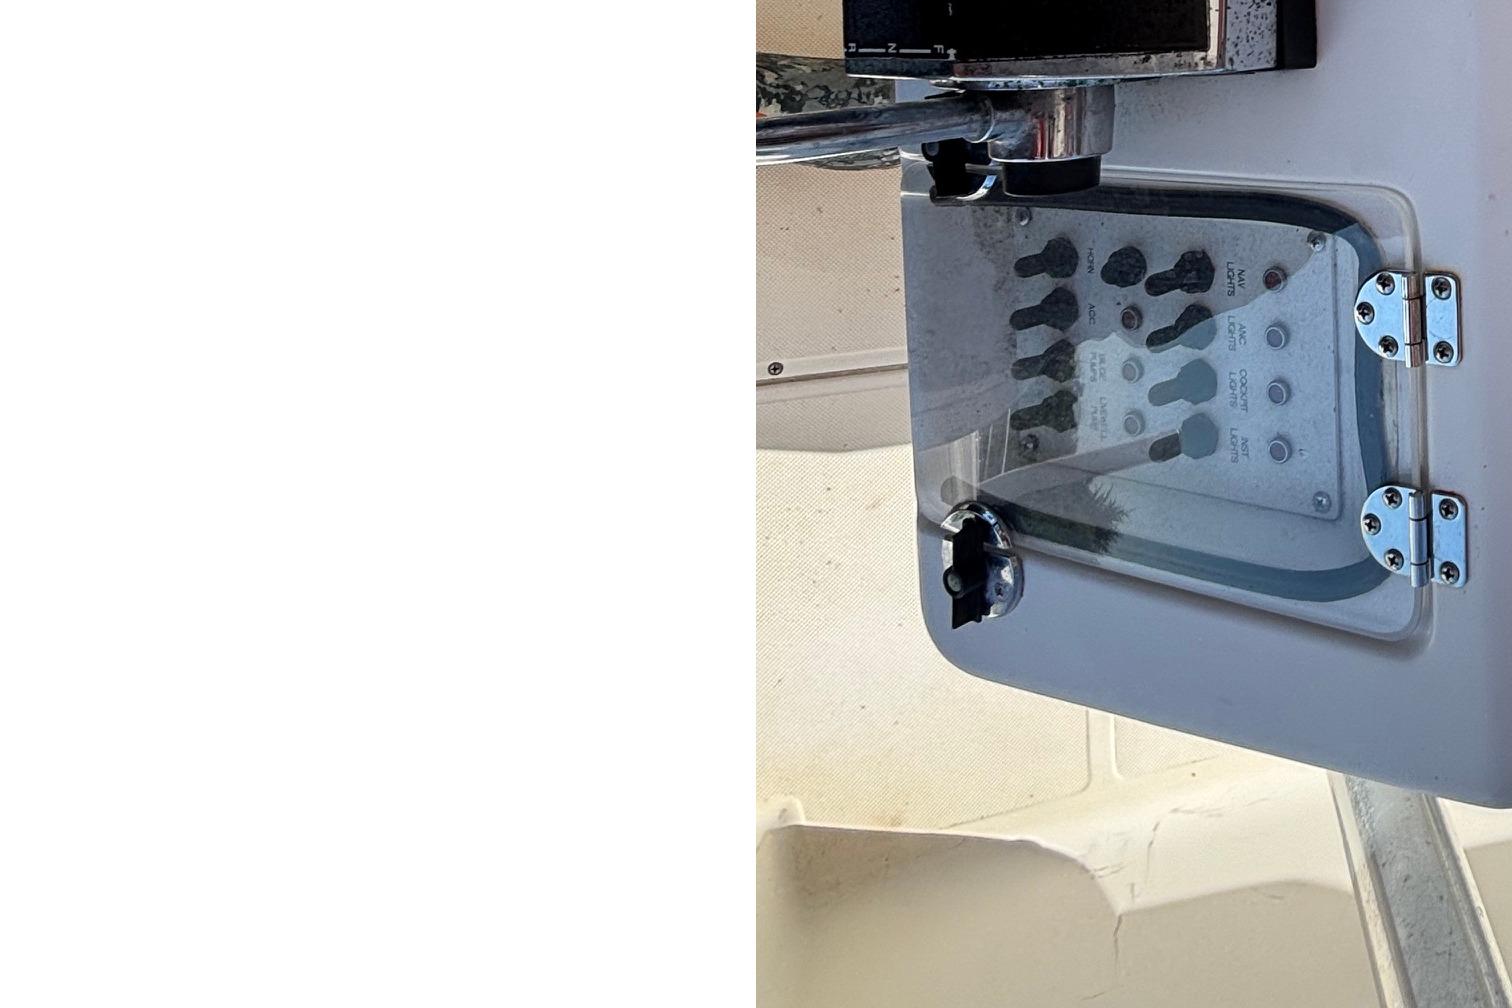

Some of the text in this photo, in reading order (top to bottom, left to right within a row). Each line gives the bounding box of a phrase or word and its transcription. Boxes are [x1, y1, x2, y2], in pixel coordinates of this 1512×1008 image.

[887, 43, 897, 53] N
[933, 44, 944, 54] F
[1227, 261, 1235, 297] LIGHTS
[1237, 269, 1246, 290] NAV
[1088, 303, 1096, 325] ACC
[1227, 315, 1236, 352] LIGHTS
[1238, 323, 1246, 346] ANC
[1229, 371, 1238, 408] LIGHTS
[1239, 369, 1248, 413] COCKPIT
[1229, 427, 1239, 464] LIGHTS
[1240, 436, 1249, 459] INST
